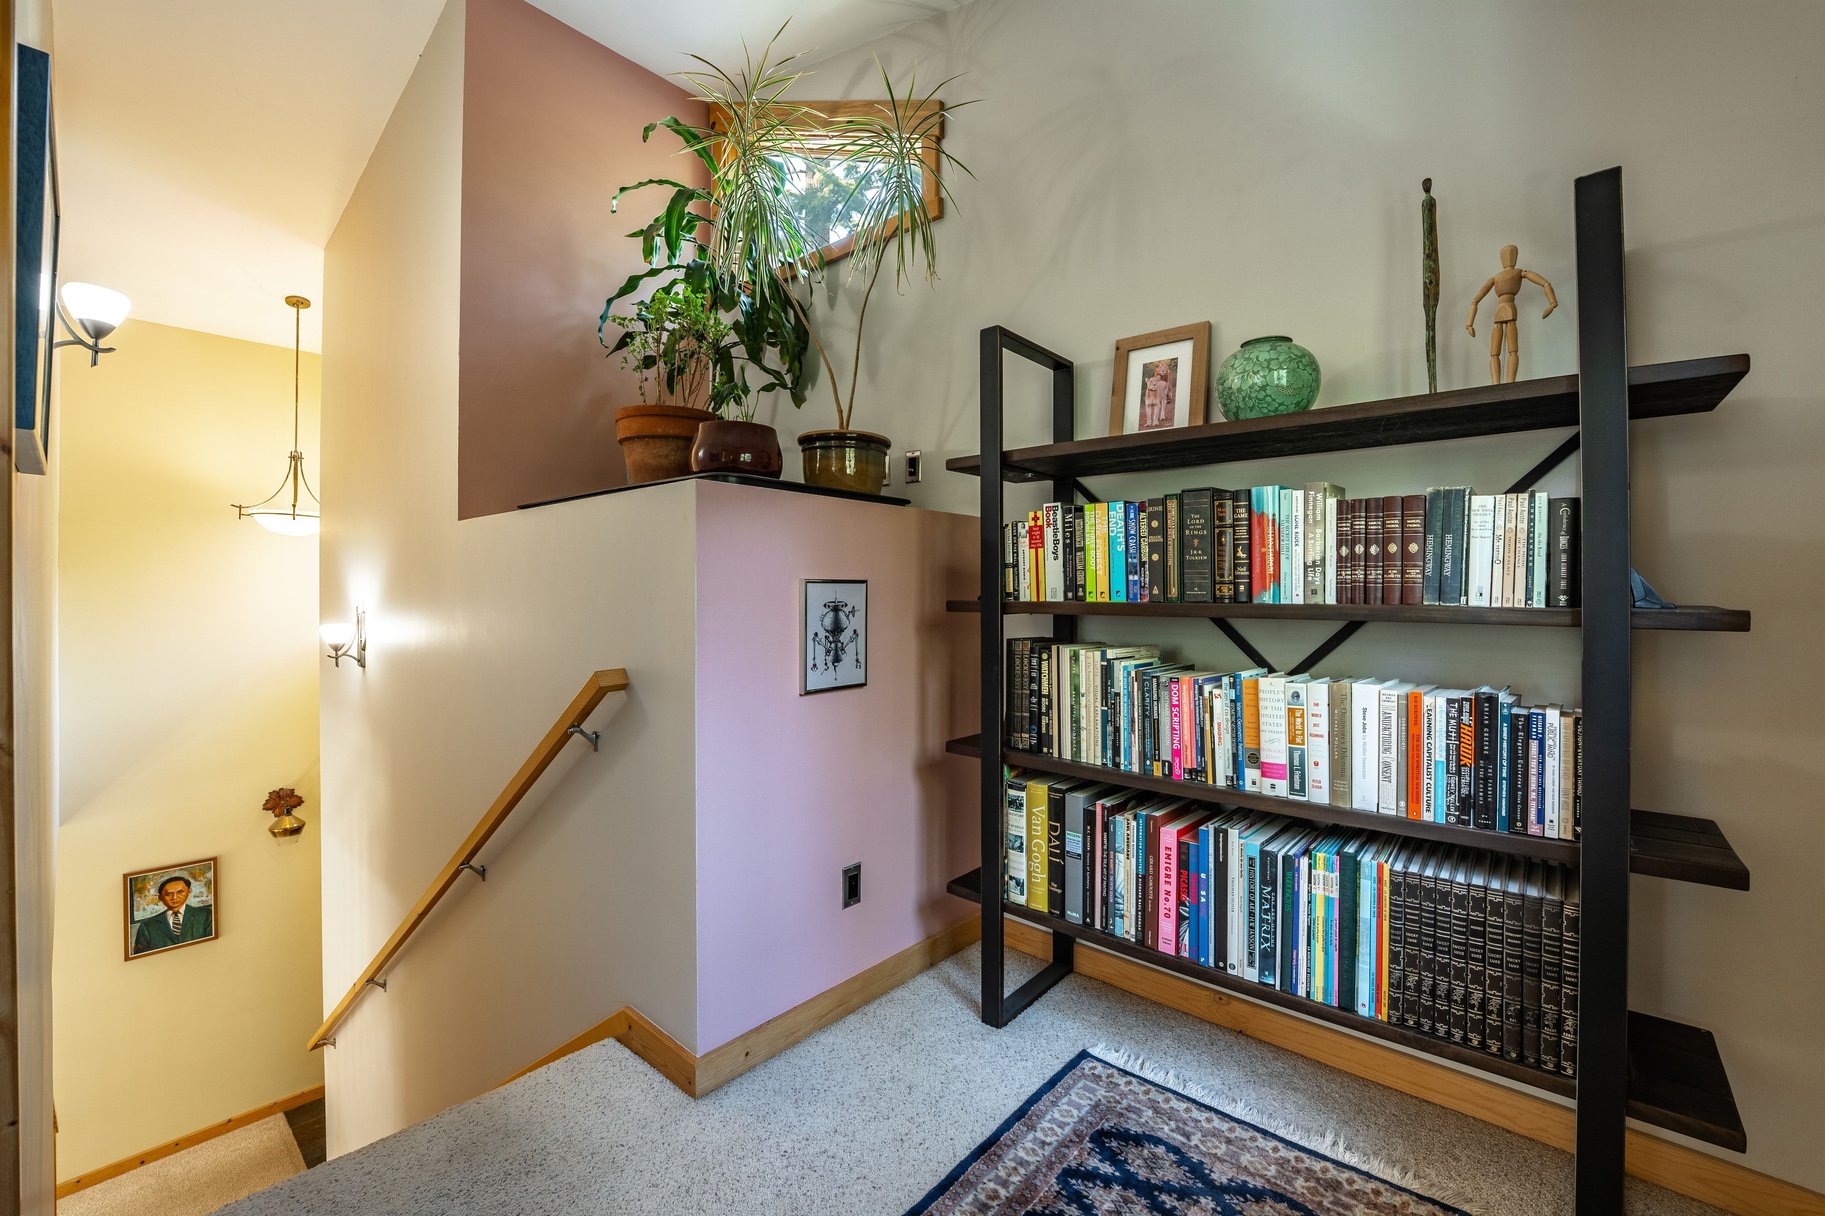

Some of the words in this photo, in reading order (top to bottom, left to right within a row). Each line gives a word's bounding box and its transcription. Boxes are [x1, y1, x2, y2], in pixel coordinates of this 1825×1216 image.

[1116, 504, 1124, 551] DEATH'S
[1426, 535, 1434, 576] HEMINGWAY
[1444, 534, 1452, 576] HEMINGWAY
[1172, 708, 1180, 749] SCRIPTING
[1460, 724, 1472, 767] HAWK
[1032, 806, 1044, 835] Van
[1028, 839, 1045, 882] Gogh
[1261, 885, 1271, 952] MATRIX
